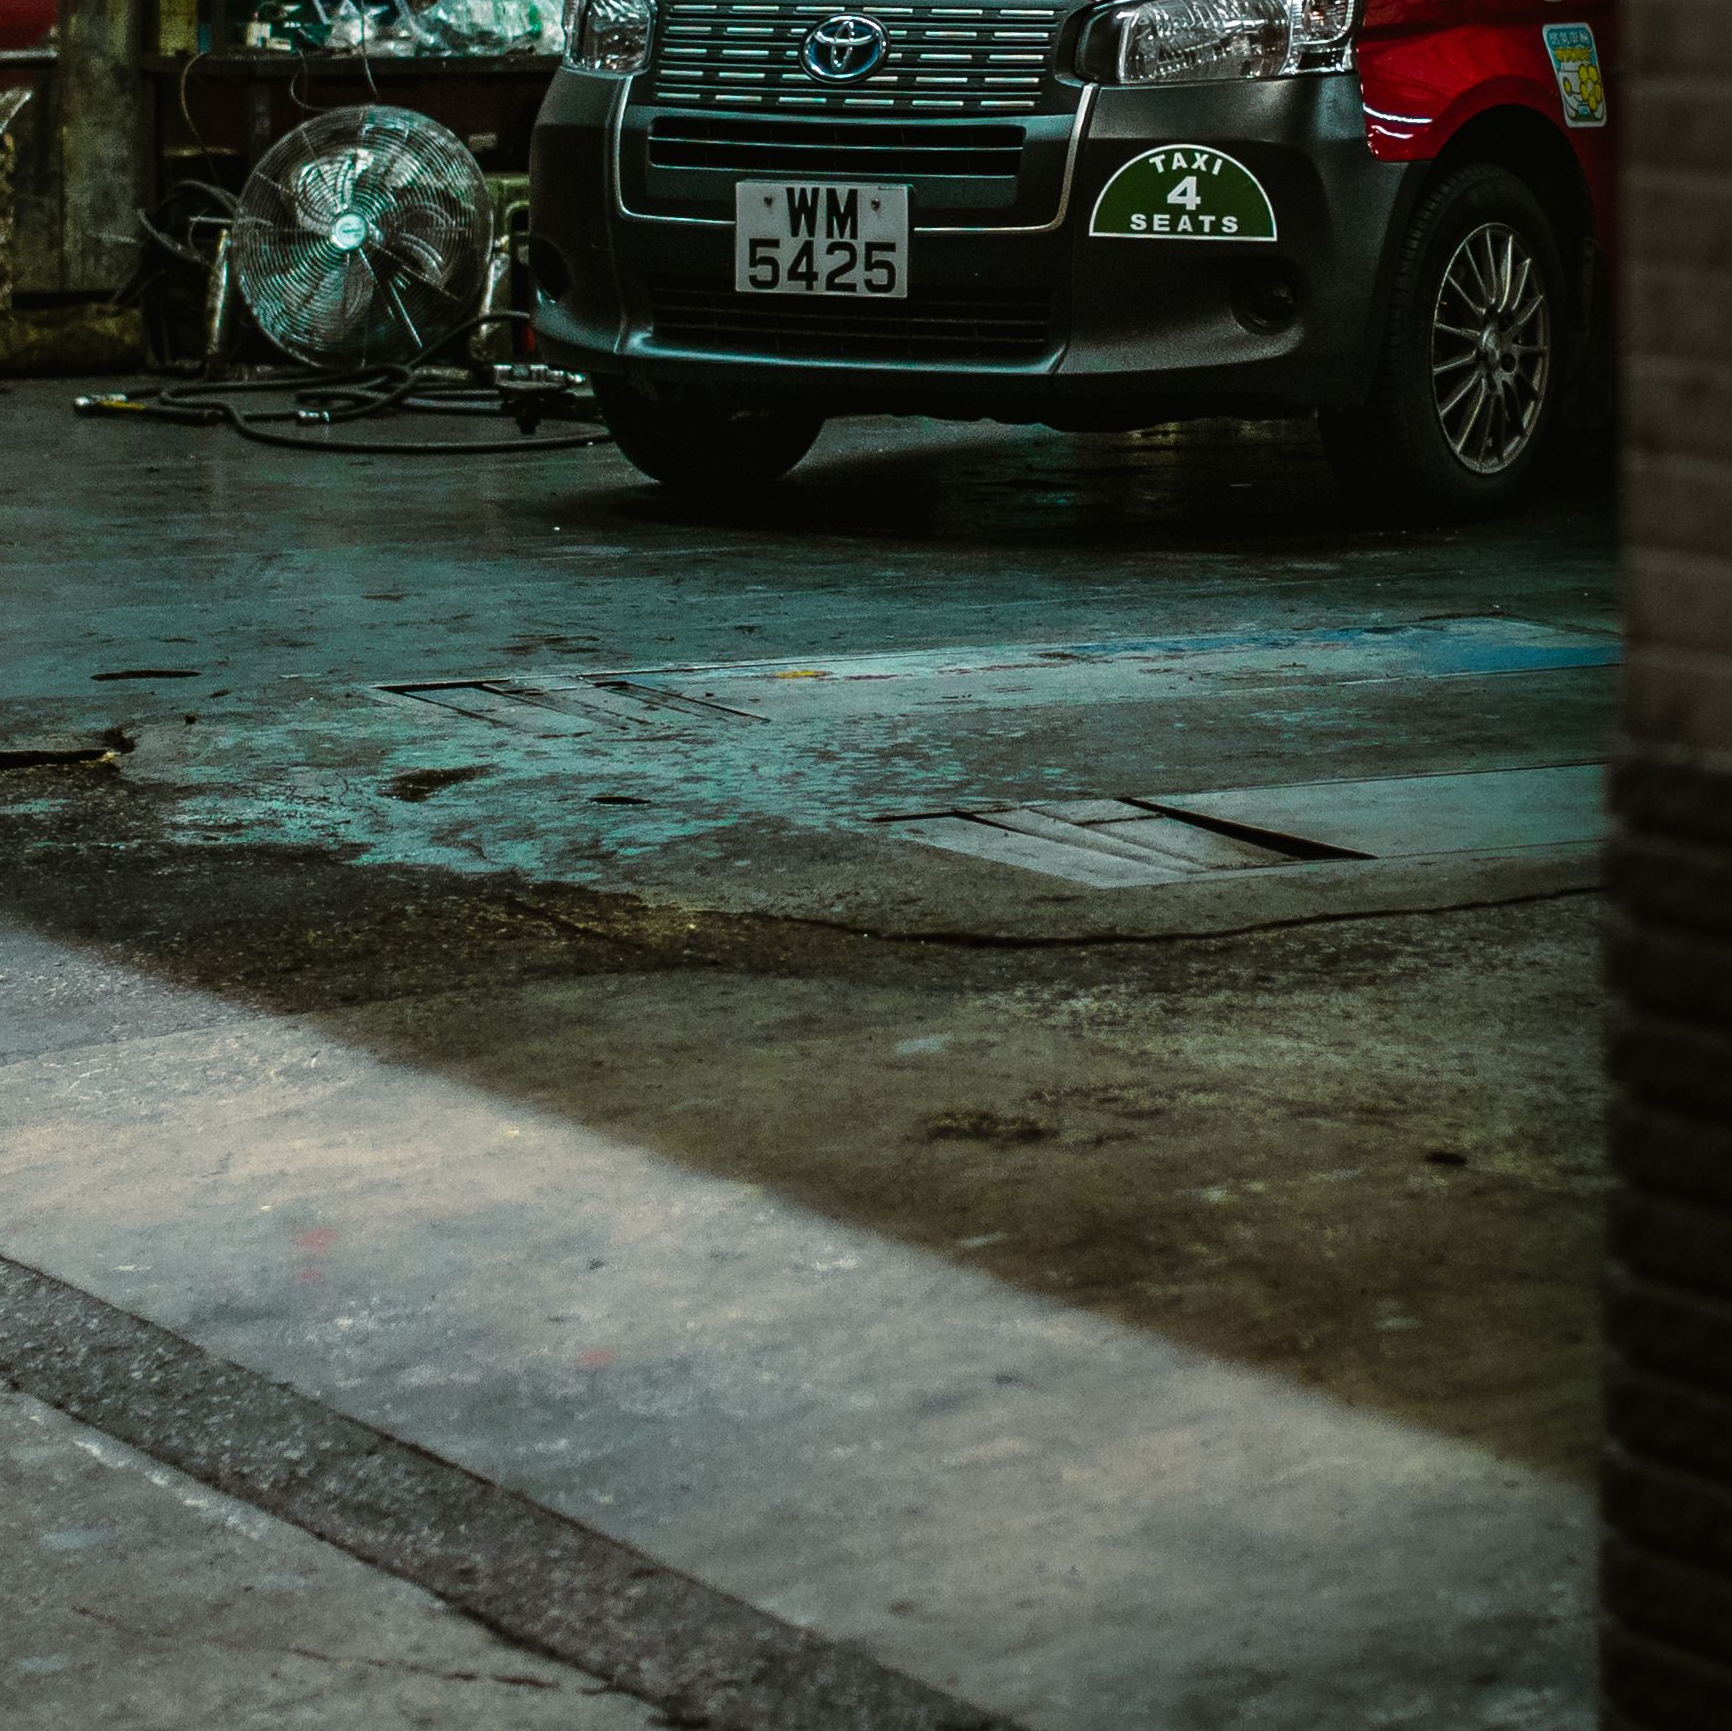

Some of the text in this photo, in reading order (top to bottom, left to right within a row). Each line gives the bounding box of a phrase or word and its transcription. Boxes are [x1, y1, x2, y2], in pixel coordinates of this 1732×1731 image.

[1149, 152, 1223, 175] TAXI
[1166, 176, 1202, 211] 4
[786, 187, 858, 239] WM
[1130, 213, 1239, 234] SEATS
[749, 238, 896, 293] 5425
